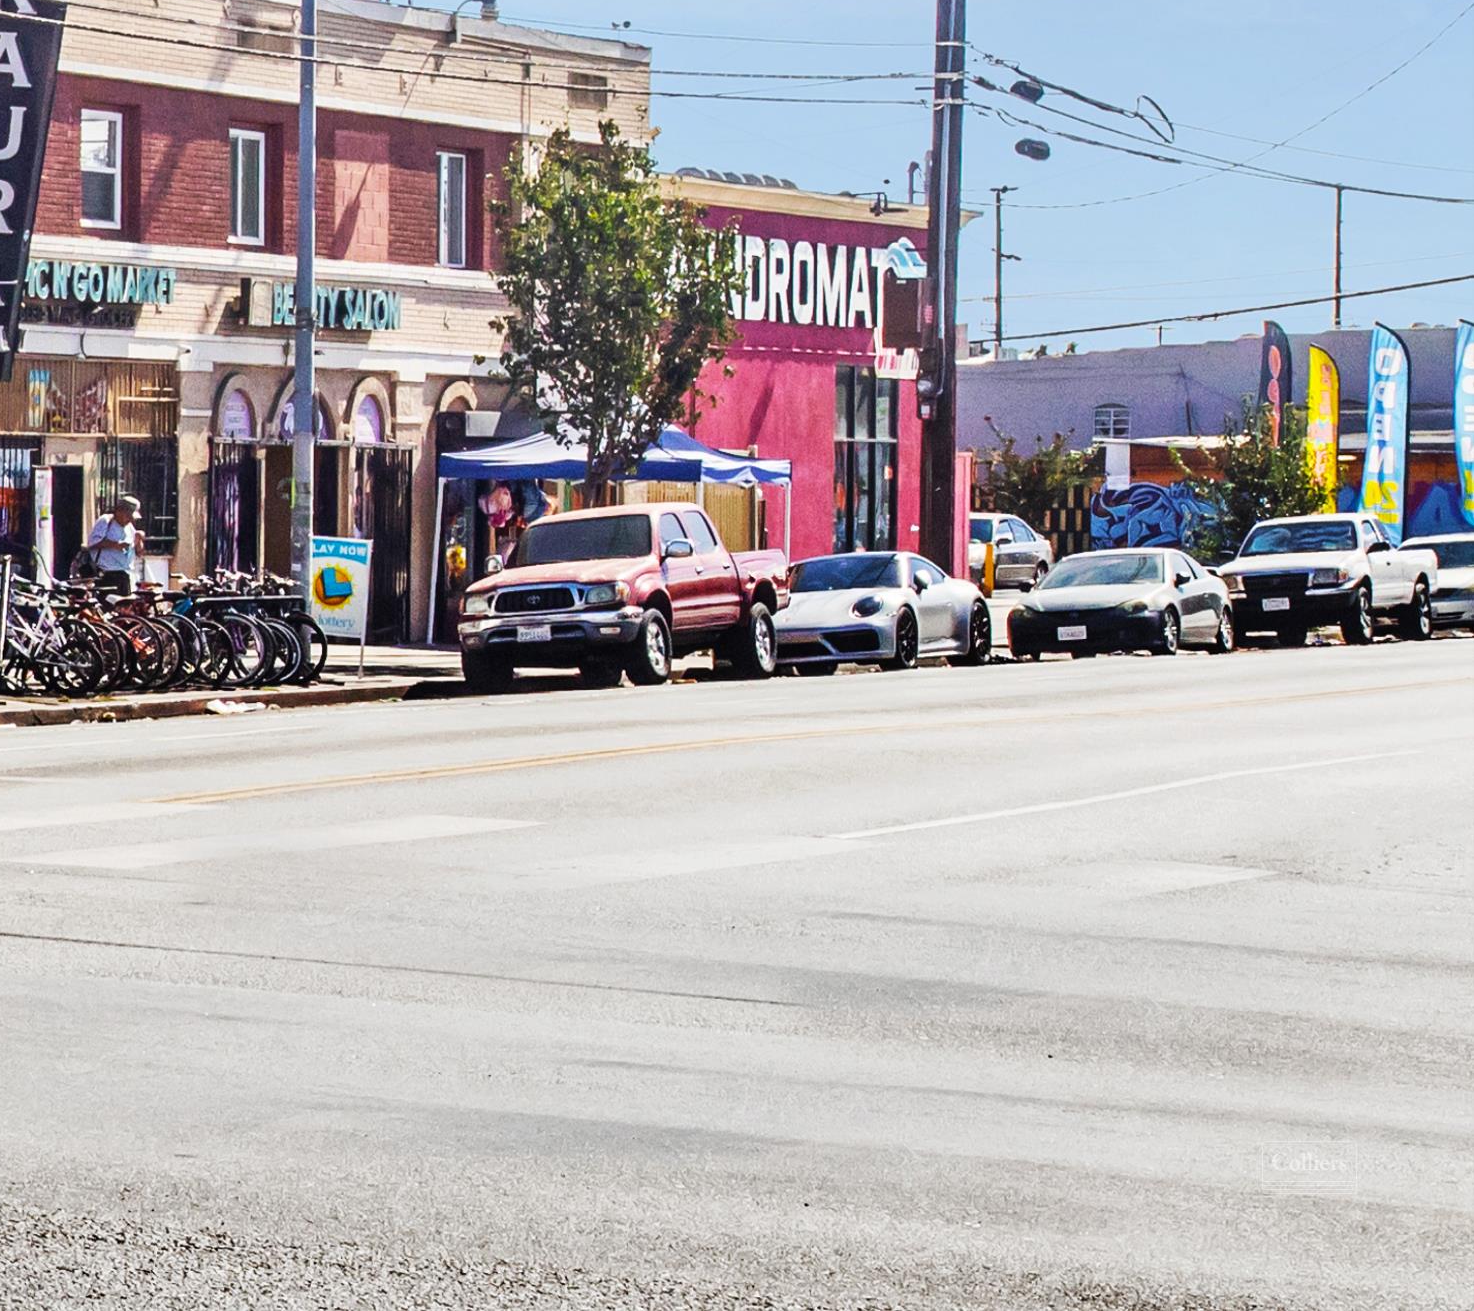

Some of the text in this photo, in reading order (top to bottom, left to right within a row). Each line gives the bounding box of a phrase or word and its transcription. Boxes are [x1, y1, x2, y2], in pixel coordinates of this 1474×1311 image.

[106, 265, 177, 305] MARKET
[344, 286, 401, 330] SALON
[313, 543, 367, 557] LAY NOW
